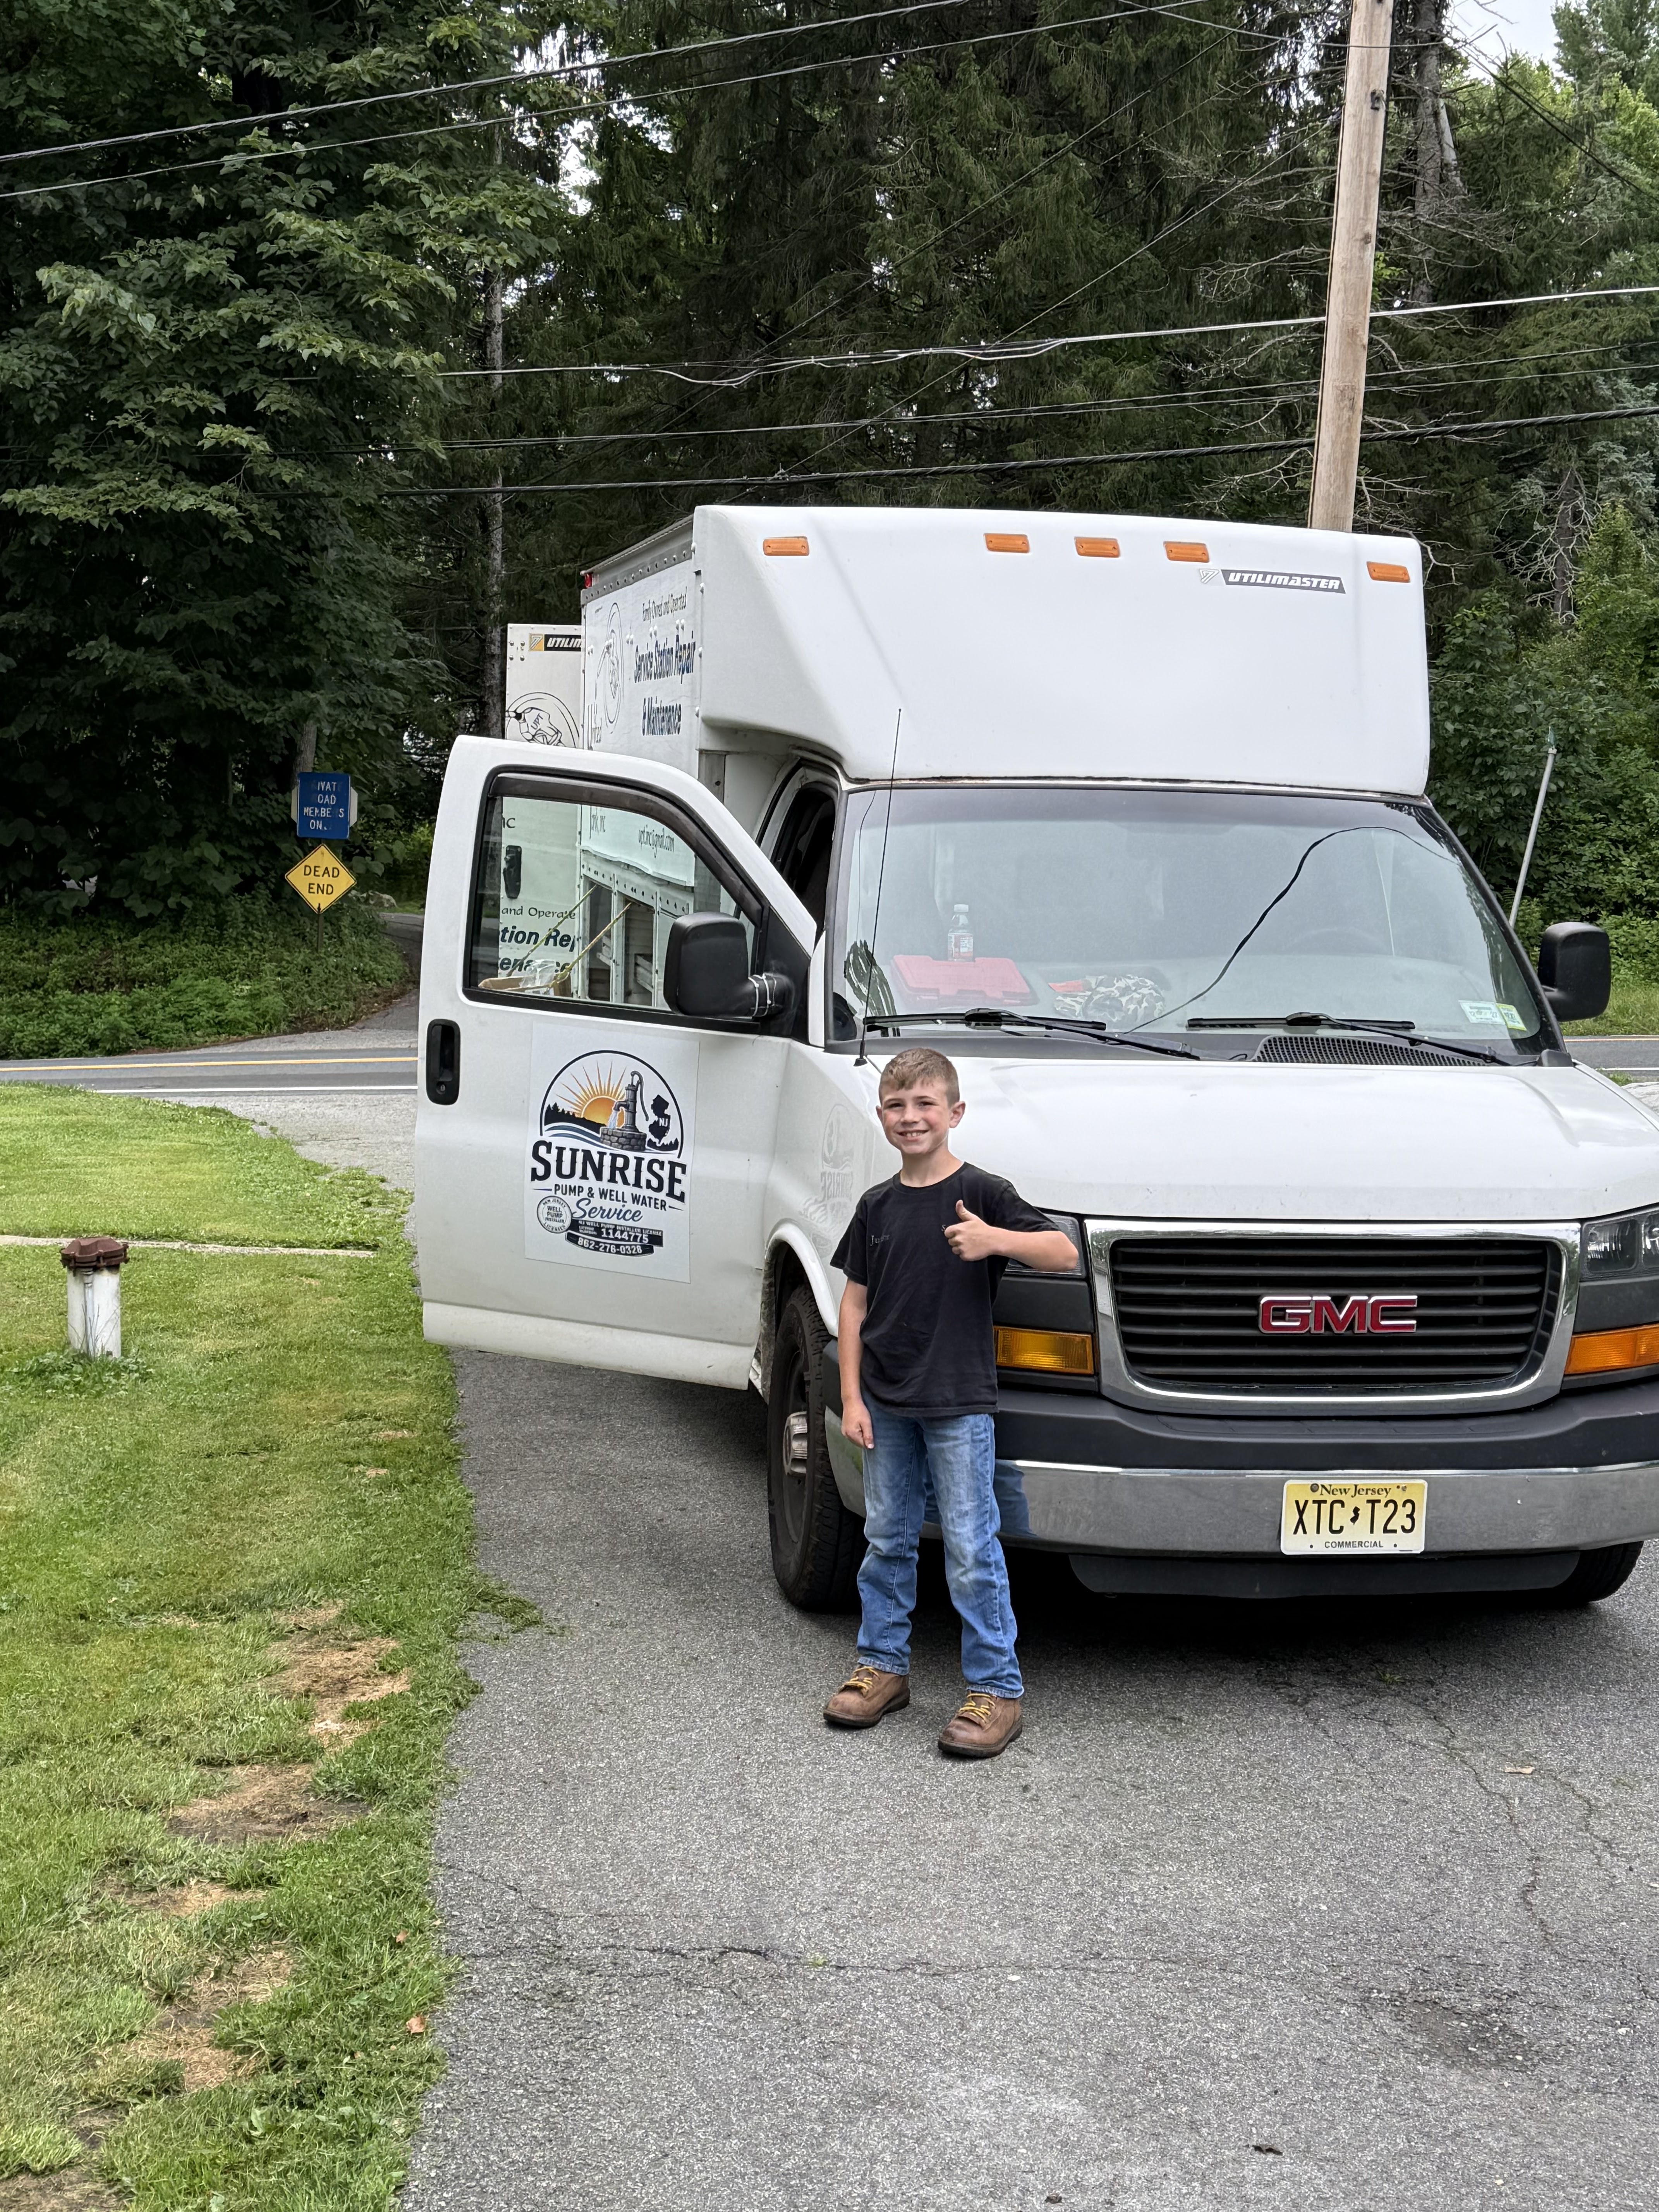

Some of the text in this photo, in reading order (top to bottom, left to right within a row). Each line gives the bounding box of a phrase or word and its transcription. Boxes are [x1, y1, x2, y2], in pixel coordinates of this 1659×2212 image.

[1228, 572, 1340, 589] UTILIMASTER
[634, 630, 696, 684] Service Station Repair
[531, 713, 543, 730] UPT
[642, 696, 682, 735] & Maintenance
[304, 865, 340, 878] DEAD
[308, 883, 334, 895] END
[501, 906, 523, 915] and
[659, 1118, 668, 1127] NJ
[531, 1140, 687, 1204] SUNRISE
[554, 1185, 667, 1211] PUMP & WELL WATER
[572, 1197, 643, 1222] Service
[601, 1228, 649, 1243] 1144775
[1258, 1295, 1418, 1333] GMC
[1320, 1484, 1391, 1498] New Jersey
[1293, 1499, 1416, 1535] XTC T23
